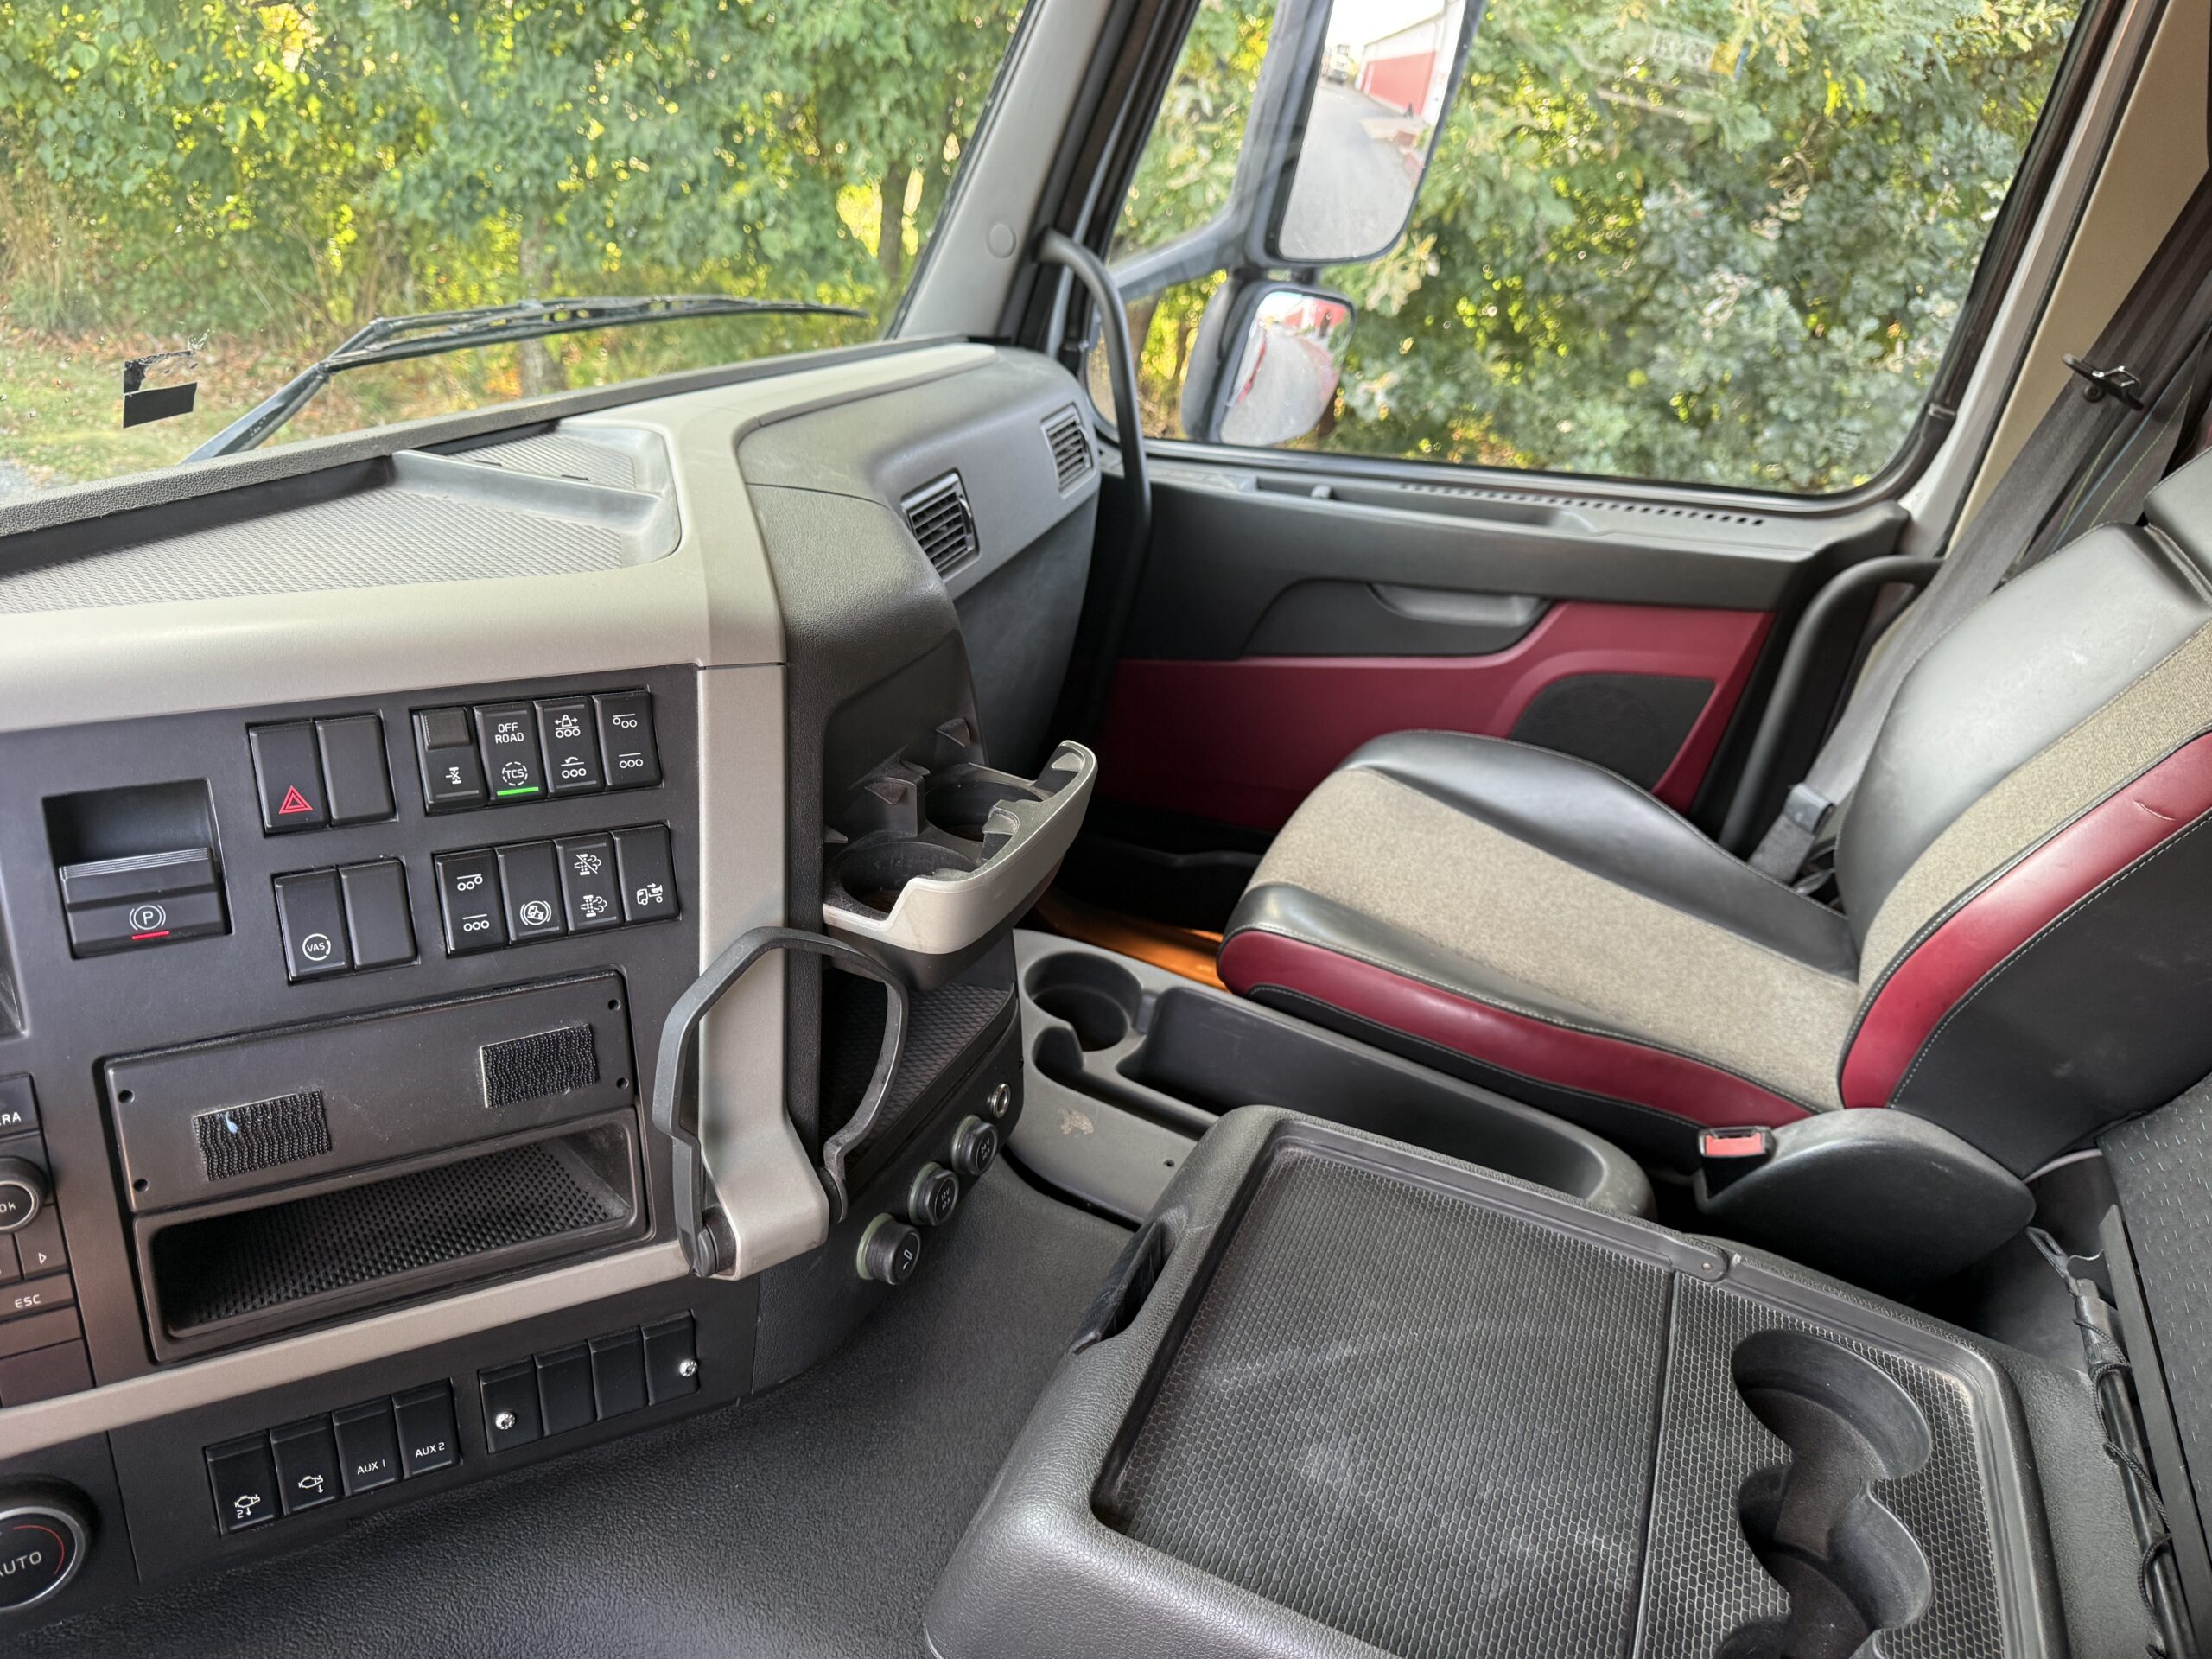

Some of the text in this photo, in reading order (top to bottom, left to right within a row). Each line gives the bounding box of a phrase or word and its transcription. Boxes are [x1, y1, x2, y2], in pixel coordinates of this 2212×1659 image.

[498, 722, 518, 733] OFF
[495, 732, 524, 744] ROAD
[505, 768, 524, 779] TCS
[143, 911, 154, 925] P
[307, 942, 325, 952] VAS
[0, 1111, 22, 1126] RA
[15, 1294, 41, 1308] ESC
[415, 1441, 446, 1459] AUX 2
[357, 1462, 378, 1476] AUX
[0, 1551, 42, 1577] UTO
